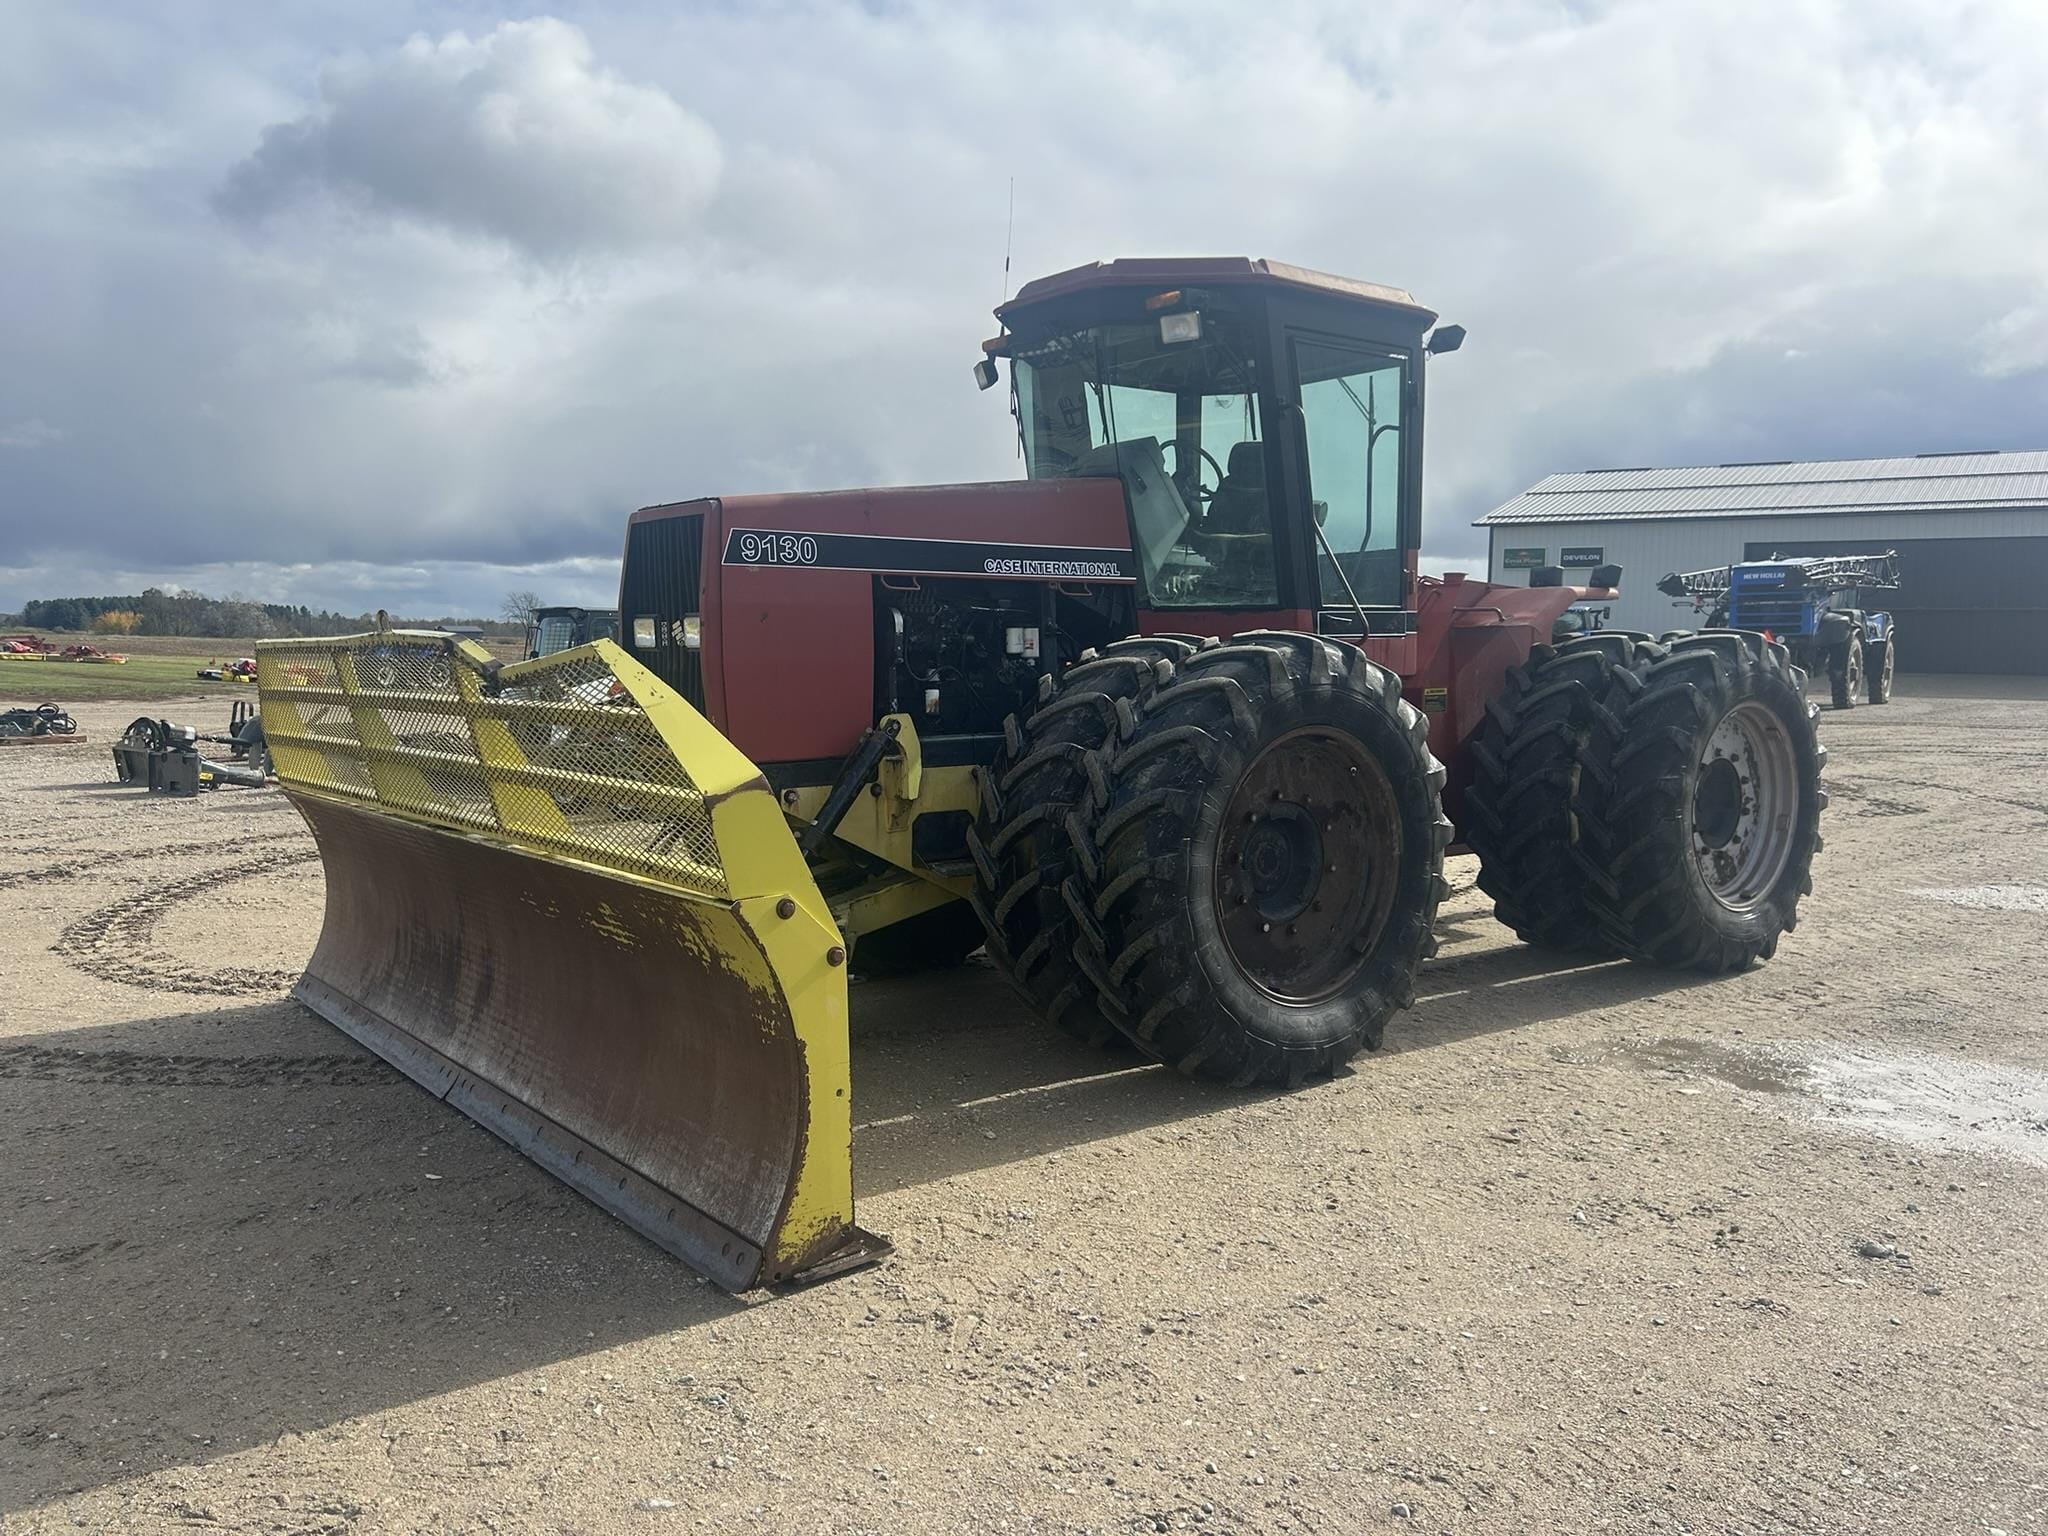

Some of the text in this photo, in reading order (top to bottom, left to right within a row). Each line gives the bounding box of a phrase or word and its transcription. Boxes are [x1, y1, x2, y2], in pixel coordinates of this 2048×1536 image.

[740, 533, 818, 564] 9130
[984, 559, 1121, 576] CASE INTERNATIONAL
